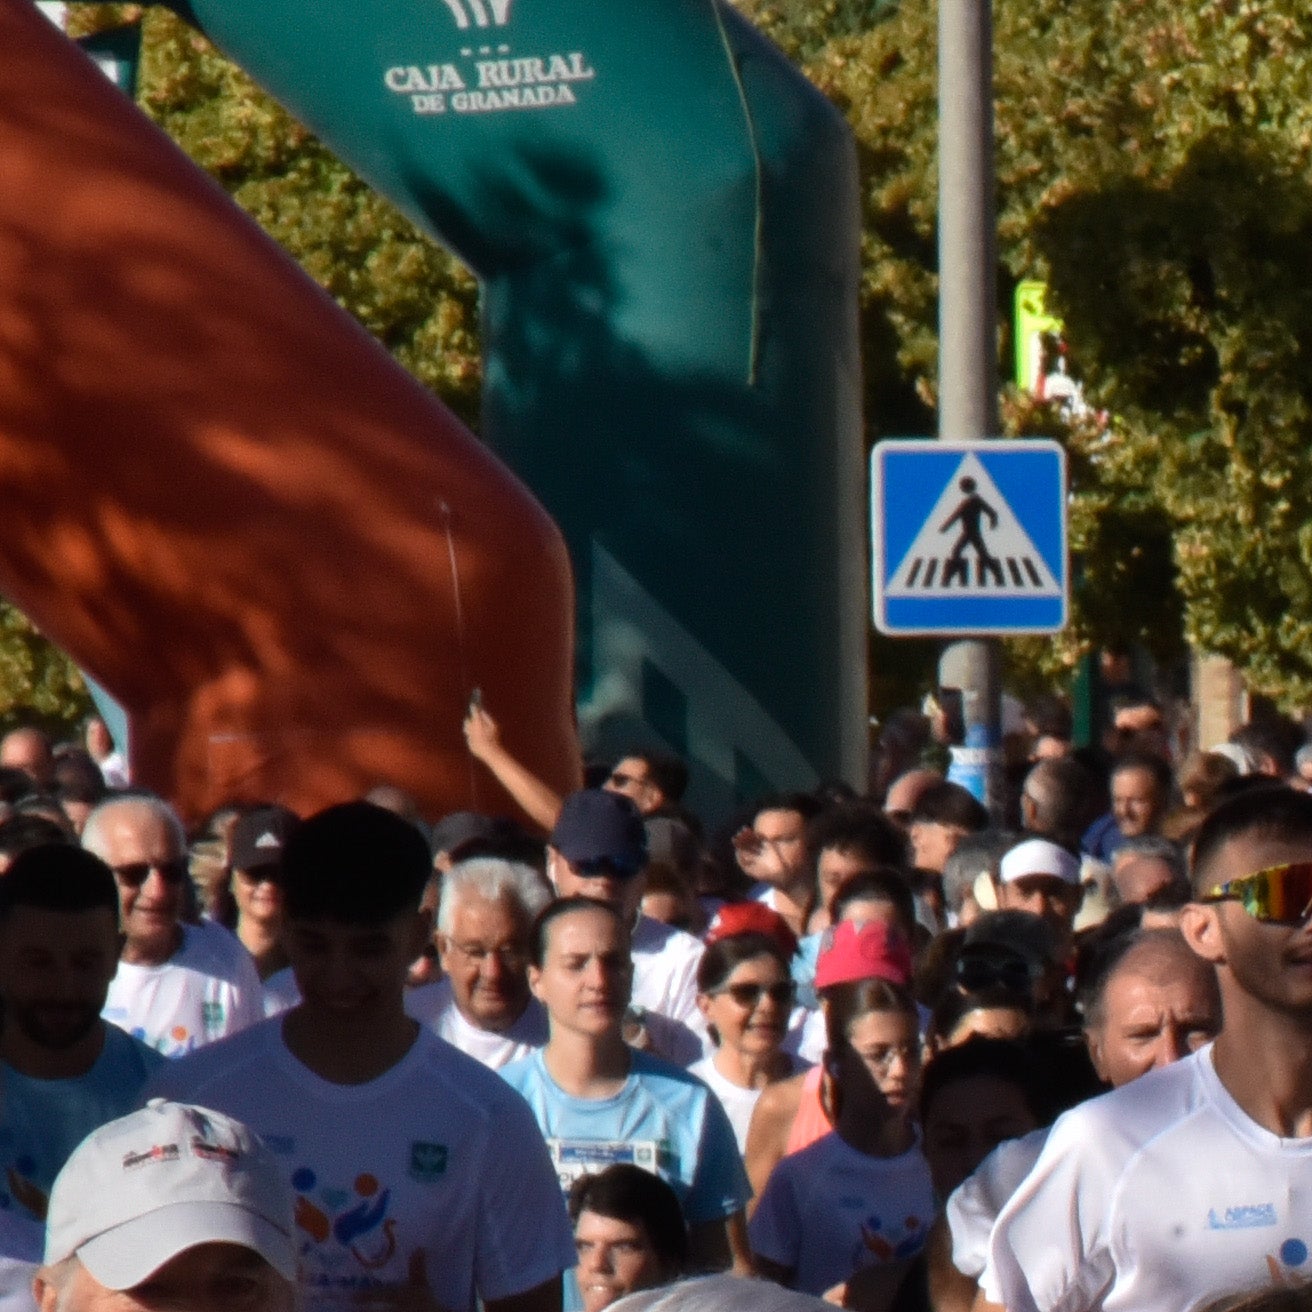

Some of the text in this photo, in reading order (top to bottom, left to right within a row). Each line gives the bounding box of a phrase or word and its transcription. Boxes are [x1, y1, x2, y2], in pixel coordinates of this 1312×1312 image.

[384, 53, 594, 92] CAJA RURAL
[411, 83, 577, 113] DE GRANADA
